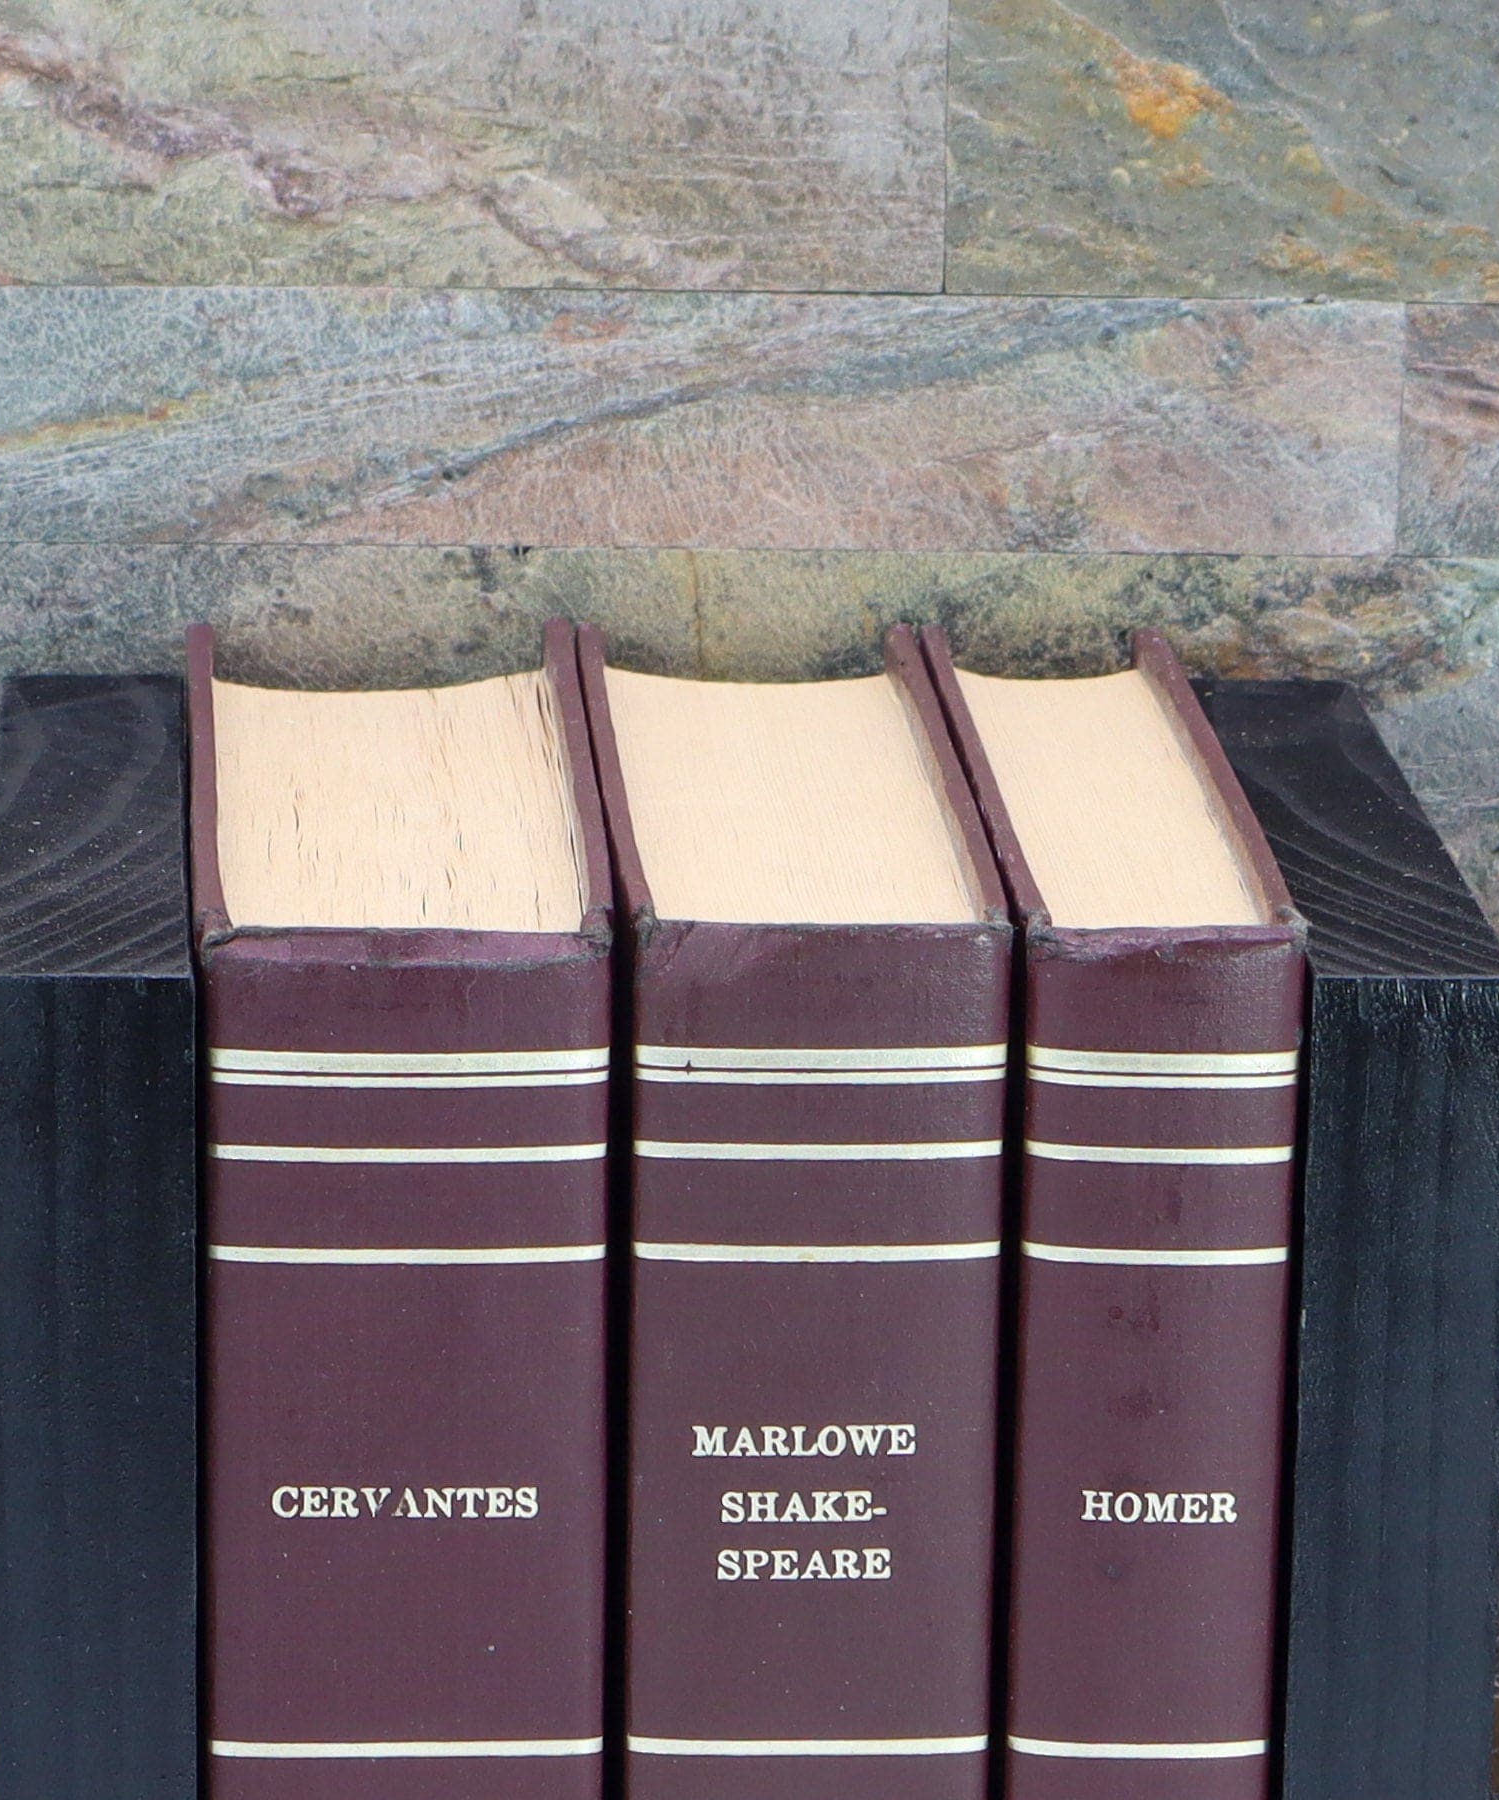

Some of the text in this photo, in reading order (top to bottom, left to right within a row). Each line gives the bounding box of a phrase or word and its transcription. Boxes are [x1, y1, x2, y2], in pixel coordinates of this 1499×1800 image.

[690, 1422, 917, 1458] MARLOWE
[270, 1484, 540, 1520] CERVANTES
[720, 1489, 888, 1524] SHAKE-
[1080, 1488, 1239, 1525] HOMER
[716, 1547, 892, 1582] SPEARE
